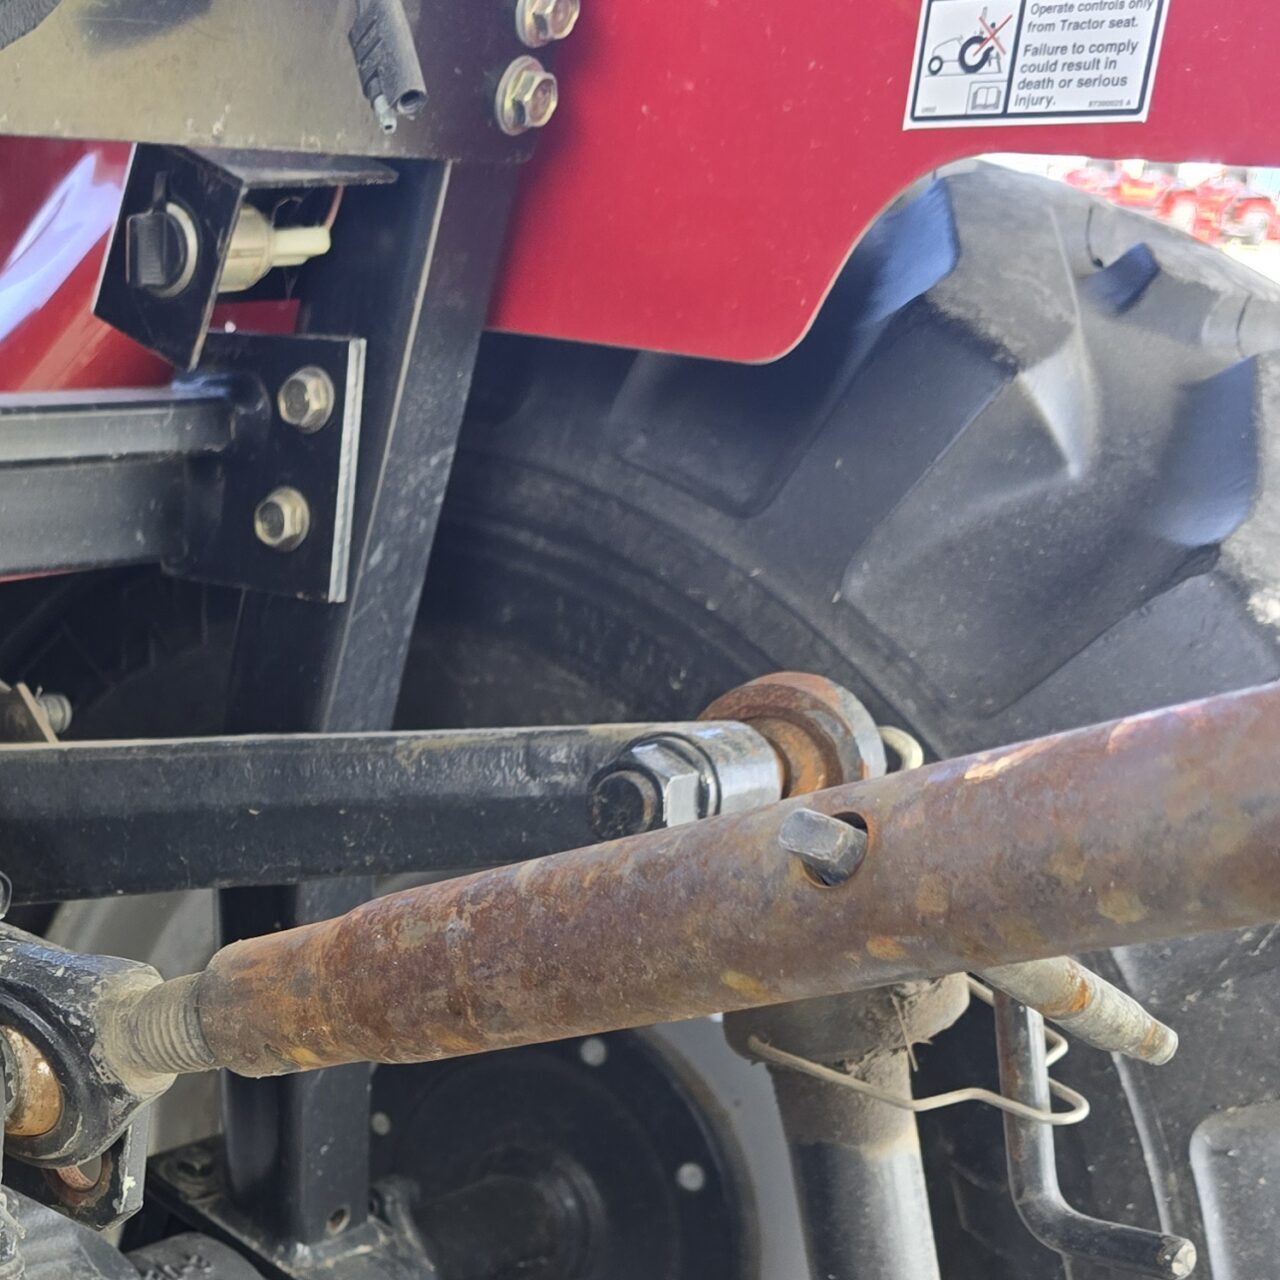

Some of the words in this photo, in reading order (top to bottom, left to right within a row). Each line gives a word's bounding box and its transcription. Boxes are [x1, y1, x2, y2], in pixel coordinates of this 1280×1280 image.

[1030, 3, 1075, 17] Operate
[1077, 0, 1125, 12] controls
[1128, 0, 1153, 11] only
[1027, 21, 1055, 33] from
[1060, 19, 1105, 31] Tractor
[1108, 16, 1138, 29] seat.
[1023, 43, 1068, 57] Failure
[1072, 42, 1084, 55] to
[1088, 39, 1139, 55] comply
[1020, 60, 1058, 73] could
[1061, 58, 1101, 72] result
[1104, 57, 1117, 70] in
[1017, 77, 1054, 90] death
[1058, 78, 1074, 89] or
[1076, 74, 1128, 88] serious
[1014, 94, 1056, 110] injury.
